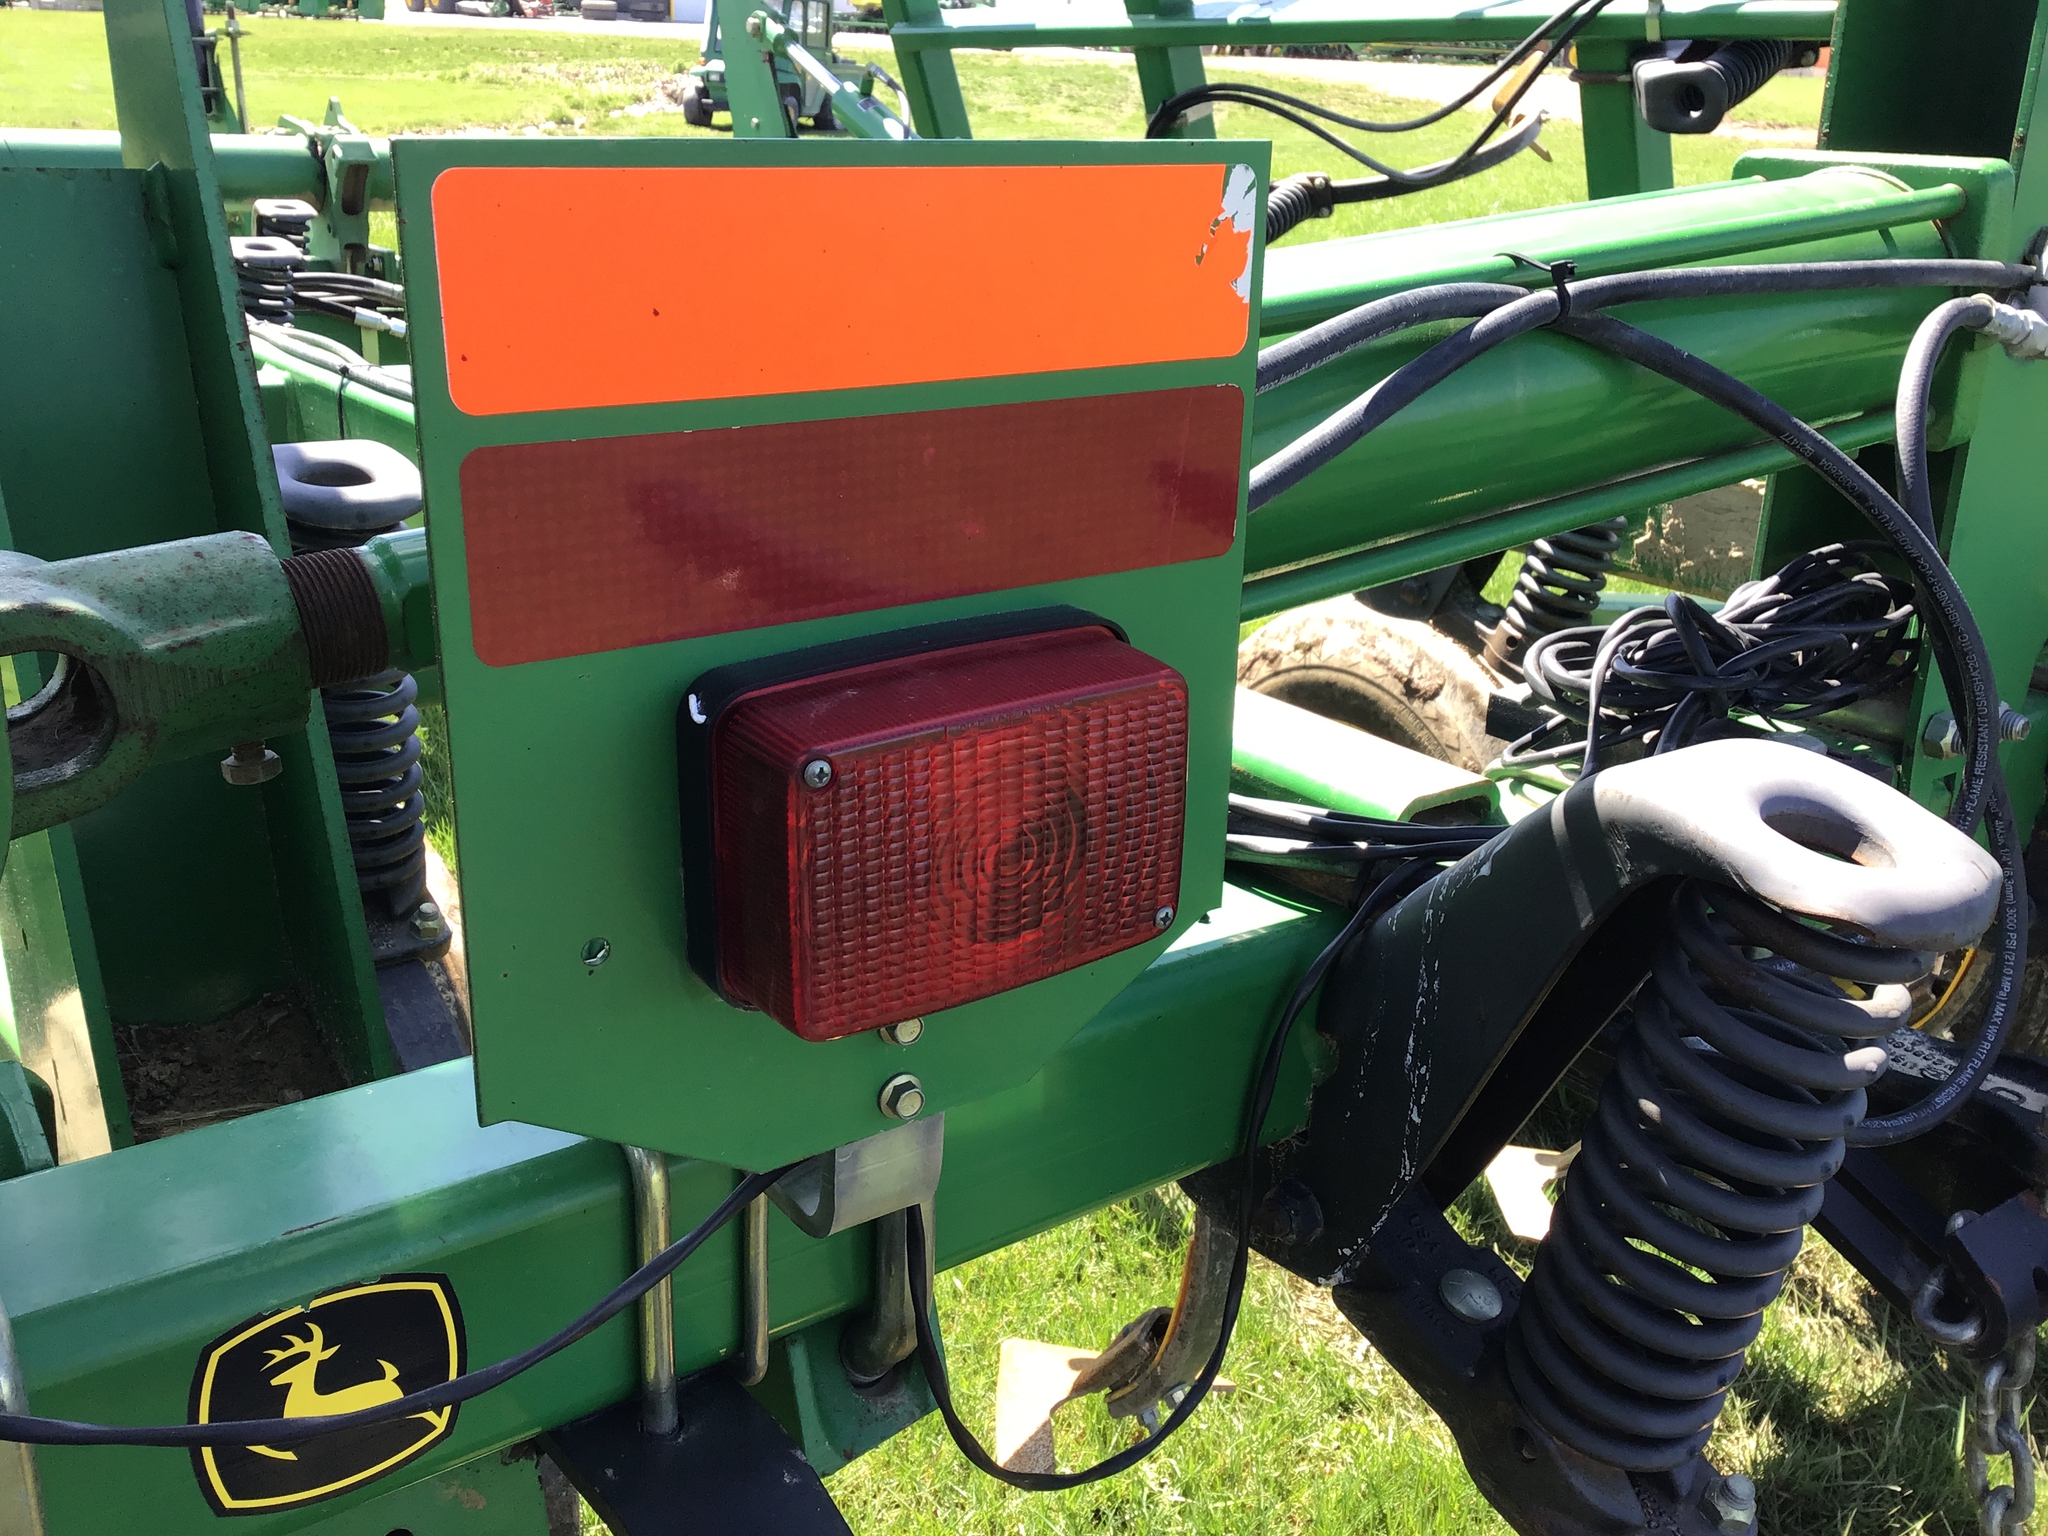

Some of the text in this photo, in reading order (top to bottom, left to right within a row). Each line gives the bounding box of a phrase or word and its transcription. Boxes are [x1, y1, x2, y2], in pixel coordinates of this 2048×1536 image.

[1884, 519, 1898, 532] IN
[1893, 530, 1921, 558] MADE
[1974, 717, 1989, 775] RESISTANT
[1965, 776, 1984, 813] FLAME
[2003, 867, 2016, 906] (6.3mm)
[2006, 907, 2017, 930] 3000
[2006, 932, 2017, 949] PSI
[2002, 951, 2016, 975] (21.0
[1996, 976, 2012, 1000] MPa)
[1990, 1001, 2007, 1025] MAX
[1985, 1025, 2000, 1042] WP
[1975, 1041, 1991, 1060] R17
[1955, 1058, 1982, 1087] FLAME
